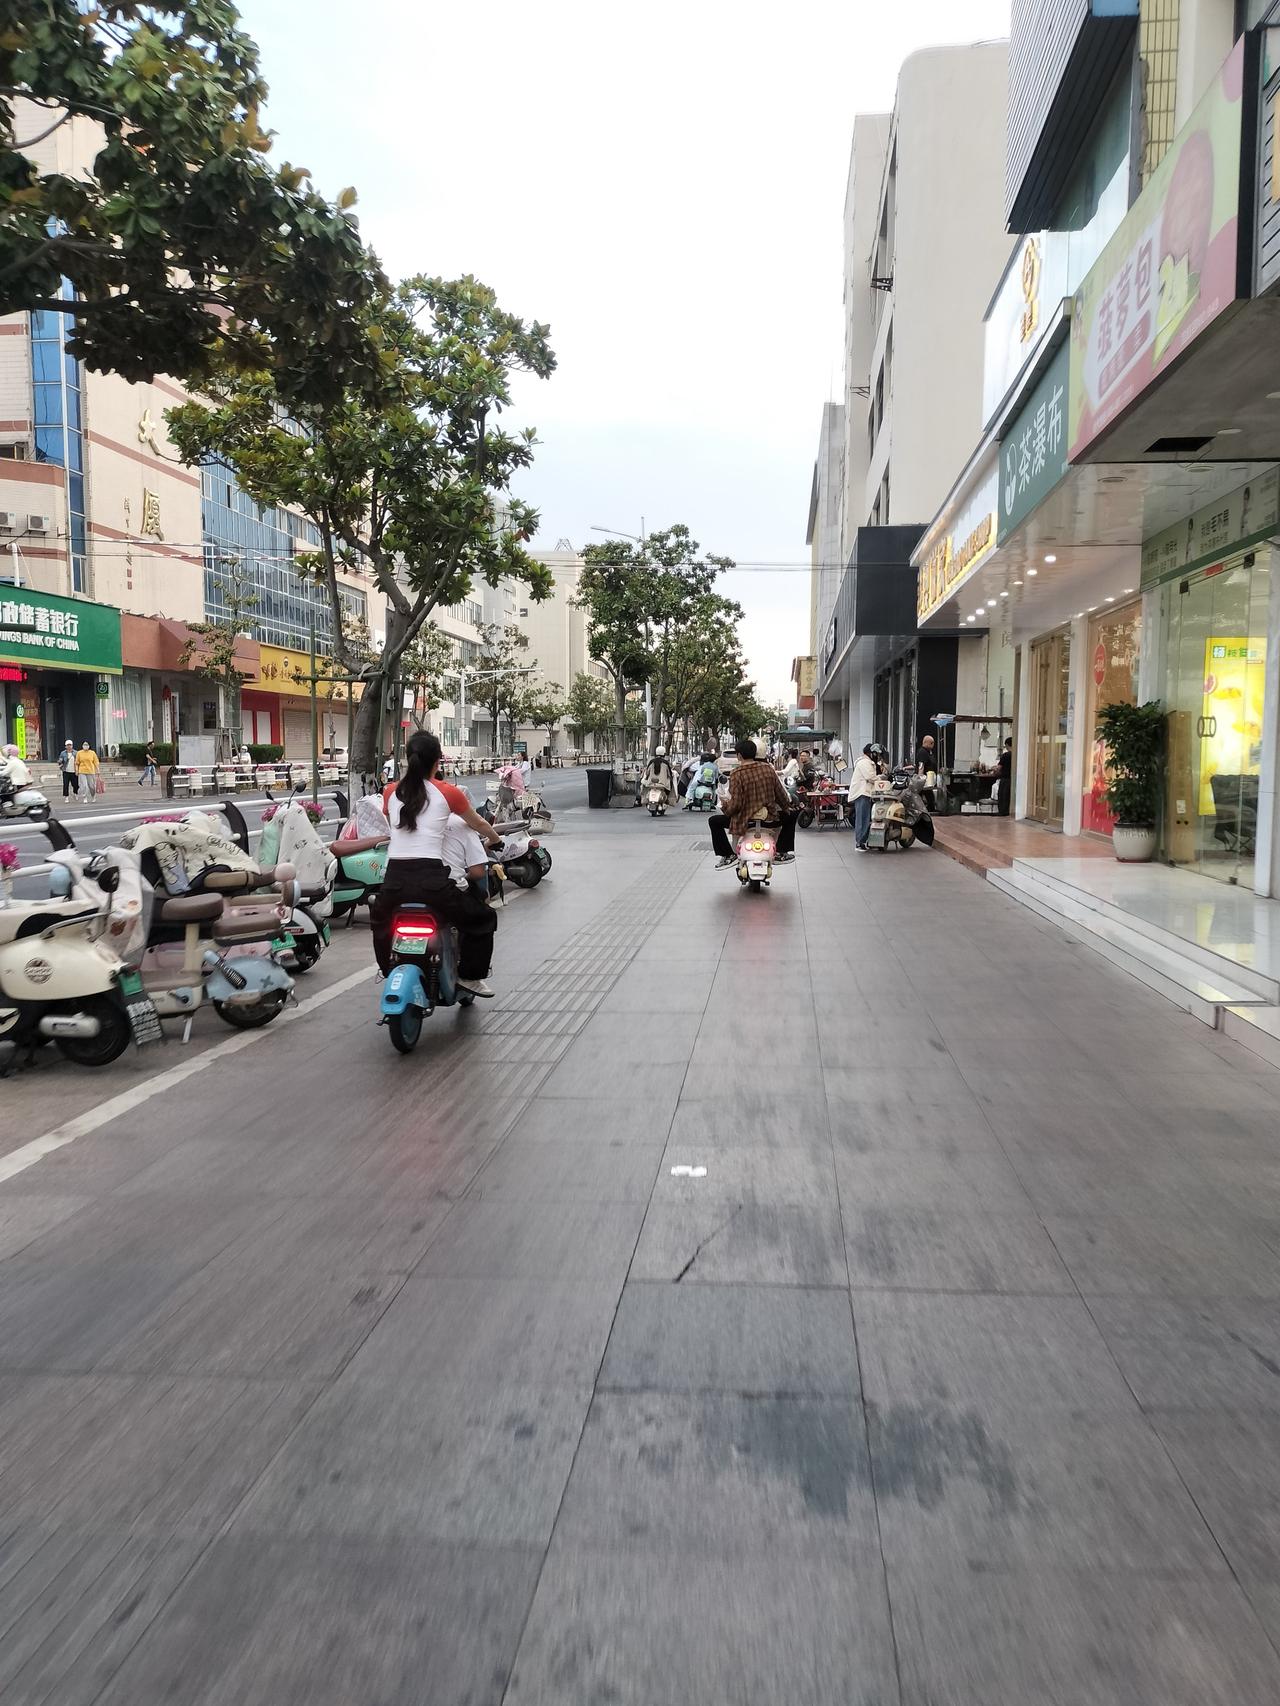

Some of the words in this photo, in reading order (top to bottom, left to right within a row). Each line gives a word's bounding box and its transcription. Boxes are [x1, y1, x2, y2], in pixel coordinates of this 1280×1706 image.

[1019, 385, 1063, 494] 茶瀑布
[0, 601, 79, 637] 政储蓄银行
[0, 631, 22, 643] INGS
[22, 633, 45, 646] BANK
[45, 636, 56, 647] OF
[56, 638, 80, 651] CHINA
